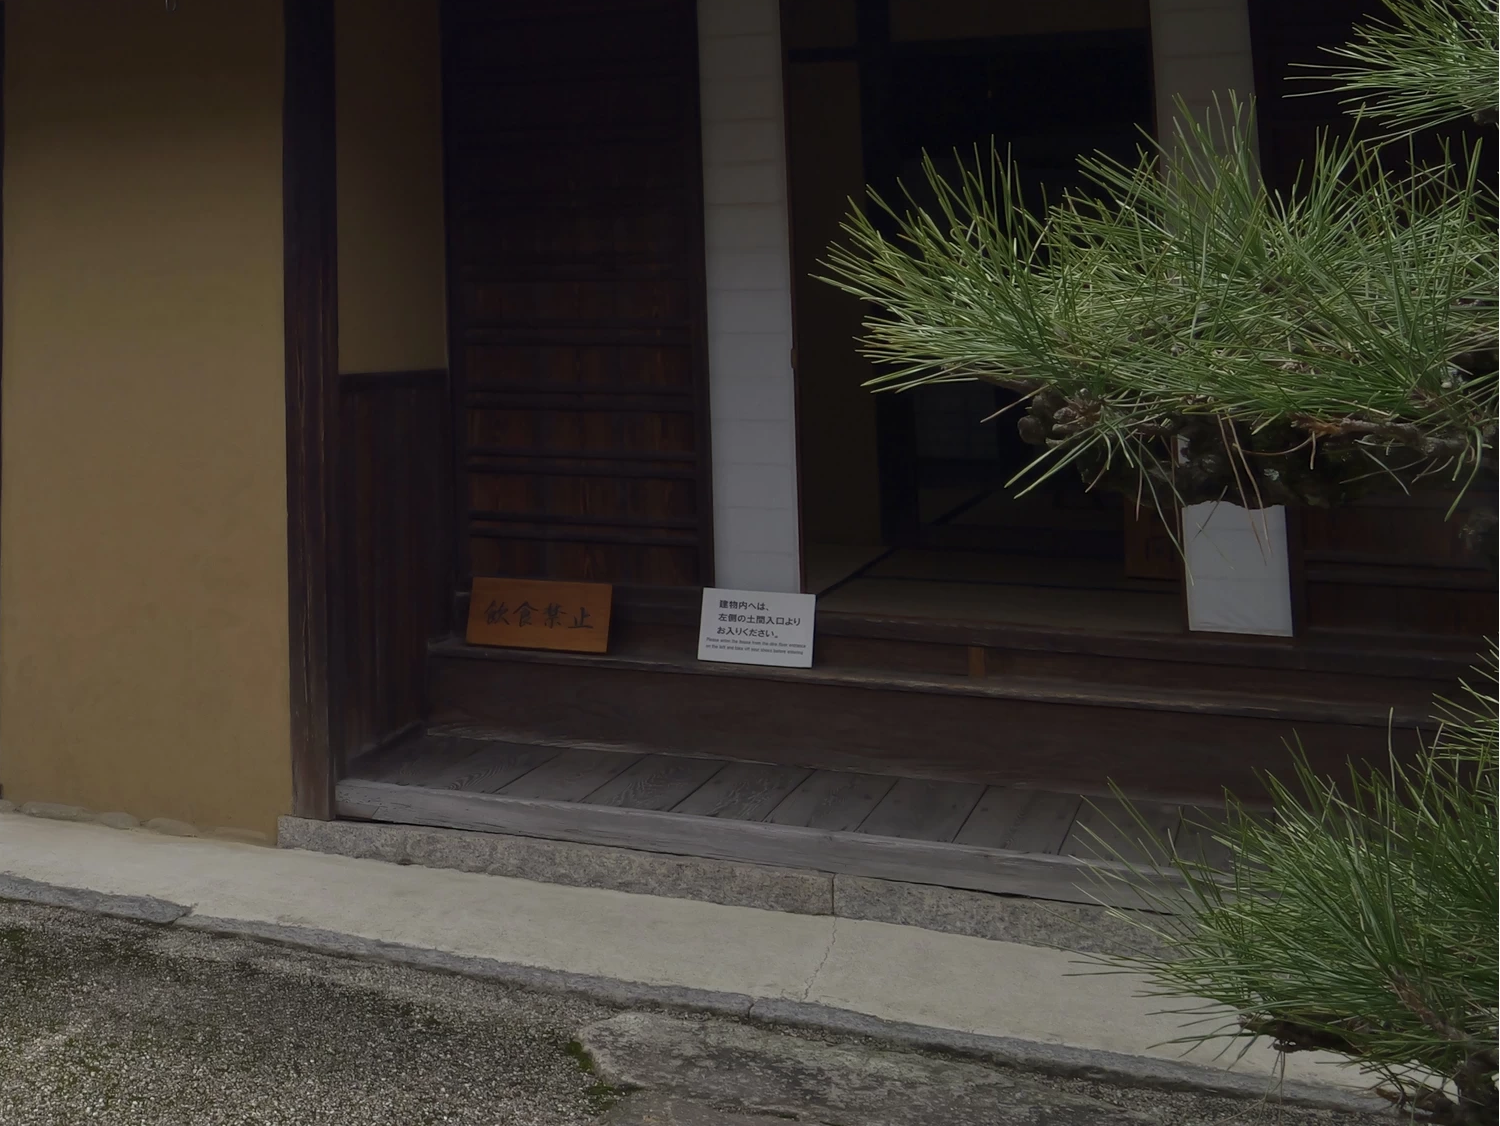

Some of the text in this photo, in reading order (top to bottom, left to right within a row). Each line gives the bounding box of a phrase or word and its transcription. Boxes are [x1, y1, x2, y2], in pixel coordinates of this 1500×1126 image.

[484, 600, 593, 629] 飲食禁止
[718, 613, 801, 626] 左側の土間入口より
[716, 626, 779, 639] お入りください。
